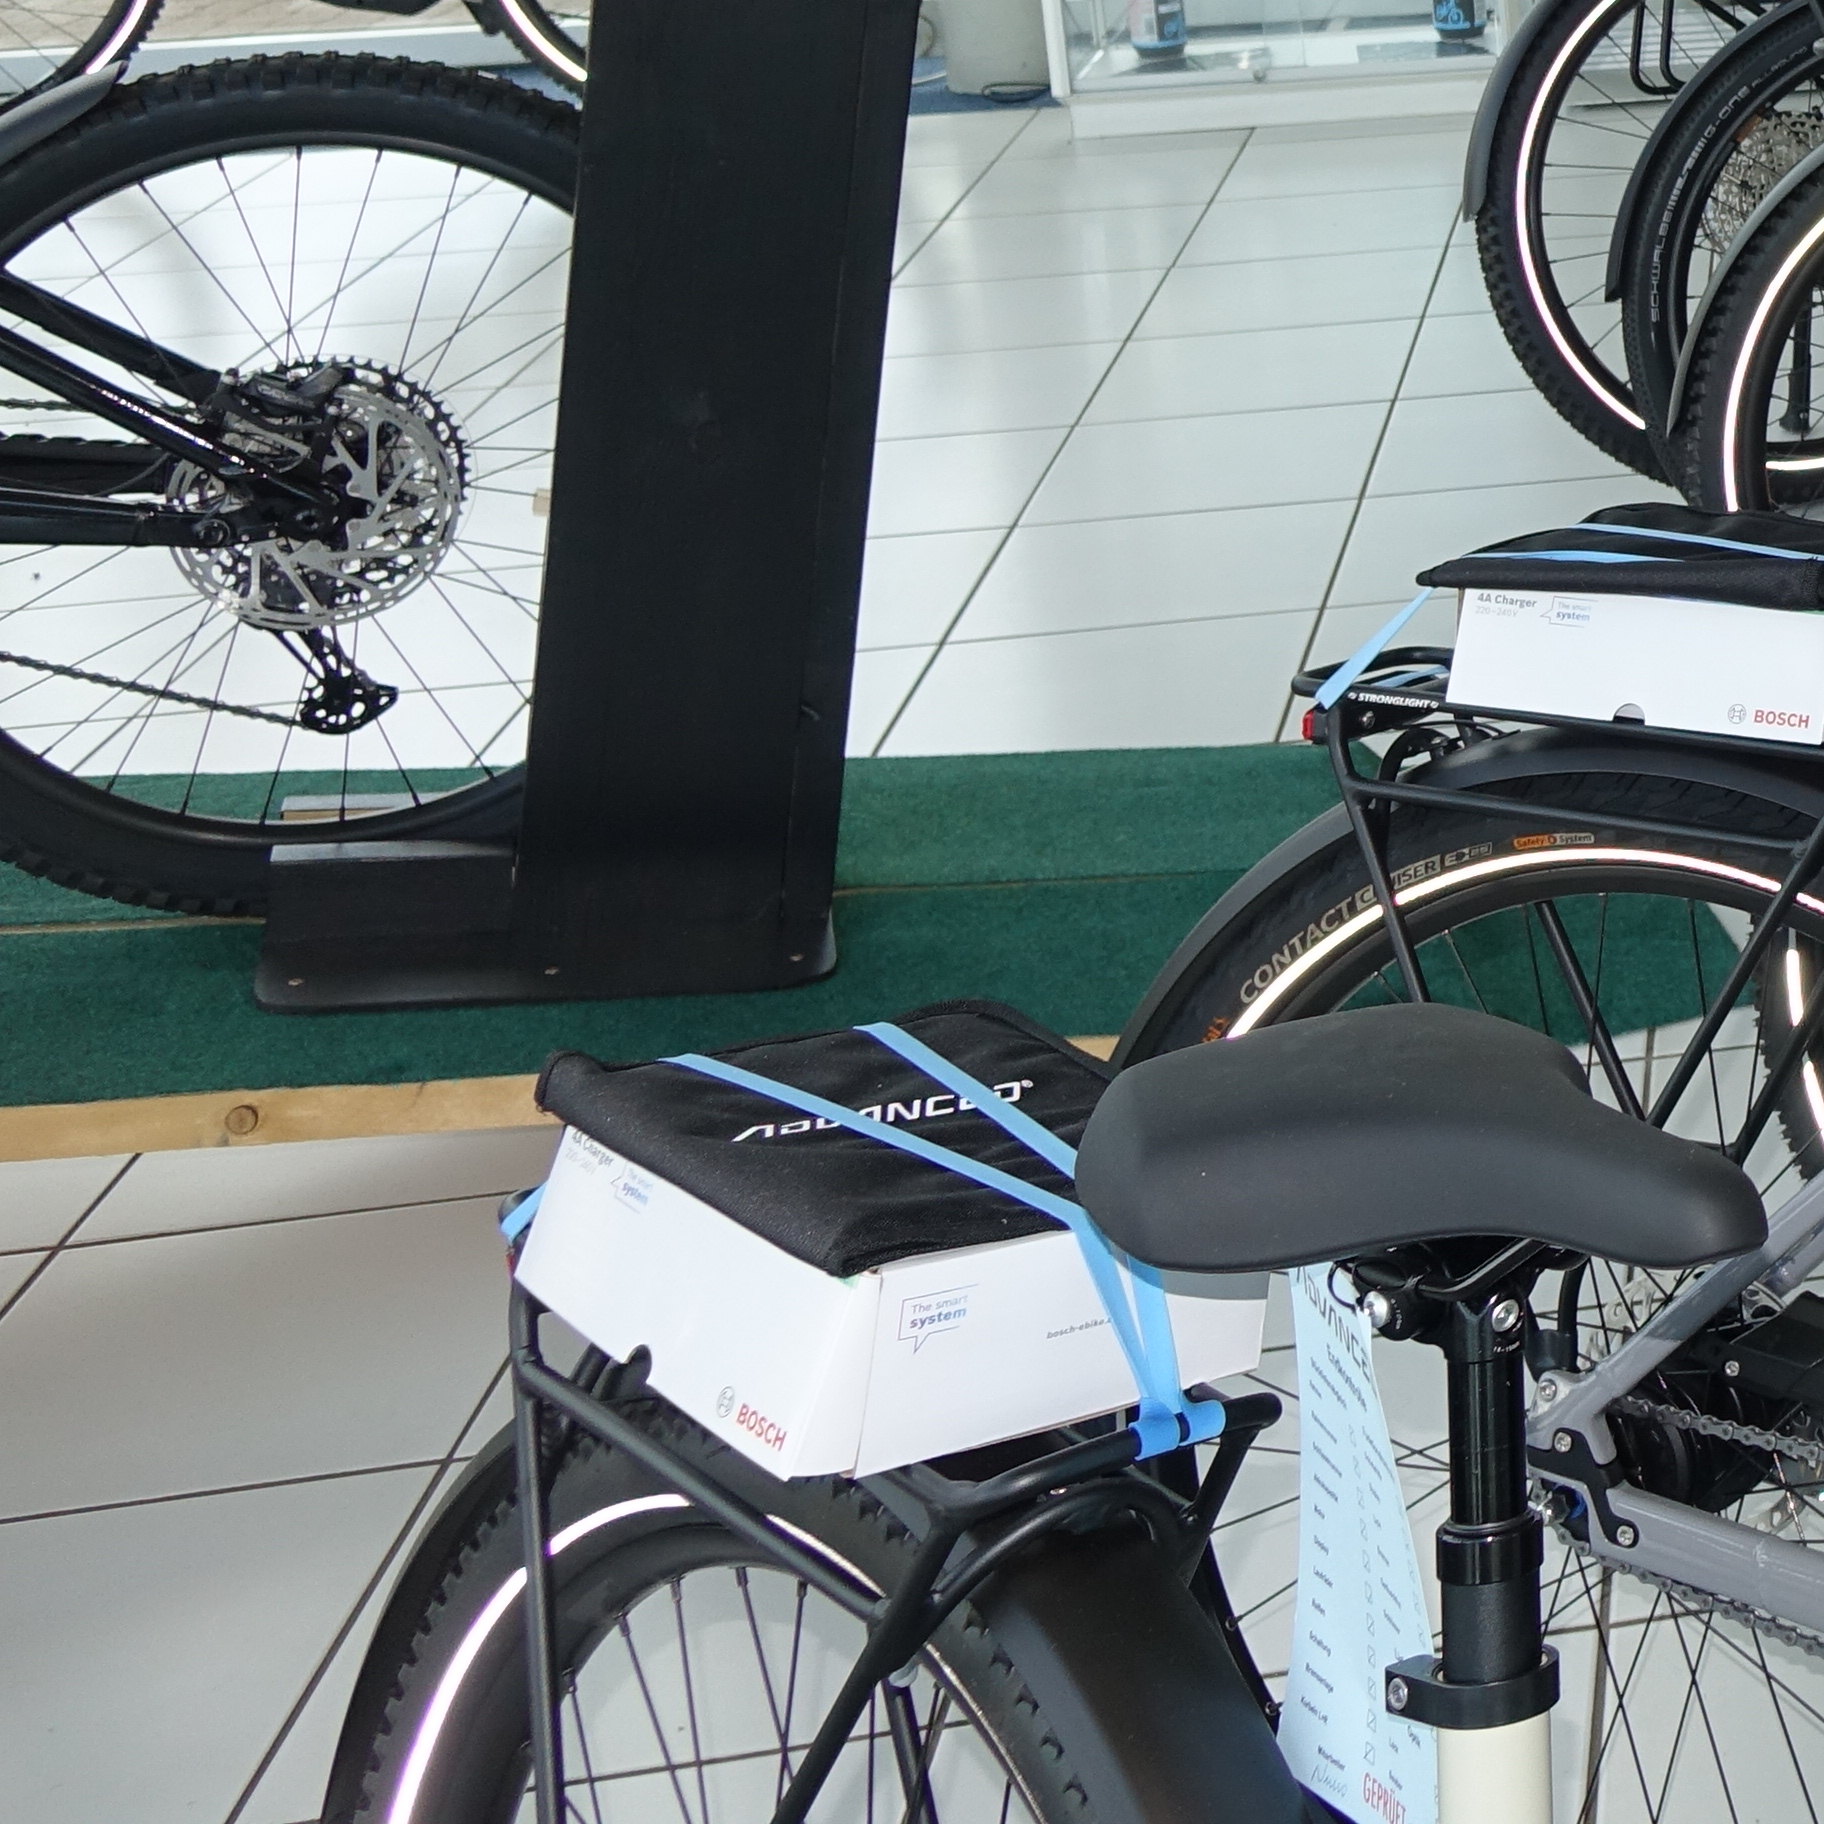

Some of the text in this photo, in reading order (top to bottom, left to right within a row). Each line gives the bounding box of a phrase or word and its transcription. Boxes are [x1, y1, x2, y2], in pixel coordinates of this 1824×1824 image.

[1475, 606, 1519, 618] 220-240V
[1477, 593, 1537, 609] 4A Charger
[1557, 601, 1592, 612] The smart
[1556, 610, 1591, 622] system
[1357, 693, 1431, 709] STRONGLIGHT
[1753, 708, 1811, 730] BOSCH
[1515, 833, 1592, 849] Safety System
[1240, 858, 1439, 1006] CONTACT CISER
[583, 1136, 615, 1167] Charger
[621, 1182, 649, 1206] system
[910, 1294, 969, 1316] The smart
[909, 1306, 968, 1331] system
[1296, 1264, 1371, 1386] ADVANCE
[735, 1402, 788, 1453] BOSCH
[1308, 1630, 1332, 1658] Schaltung
[1362, 1770, 1407, 1824] GEPRÜFT
